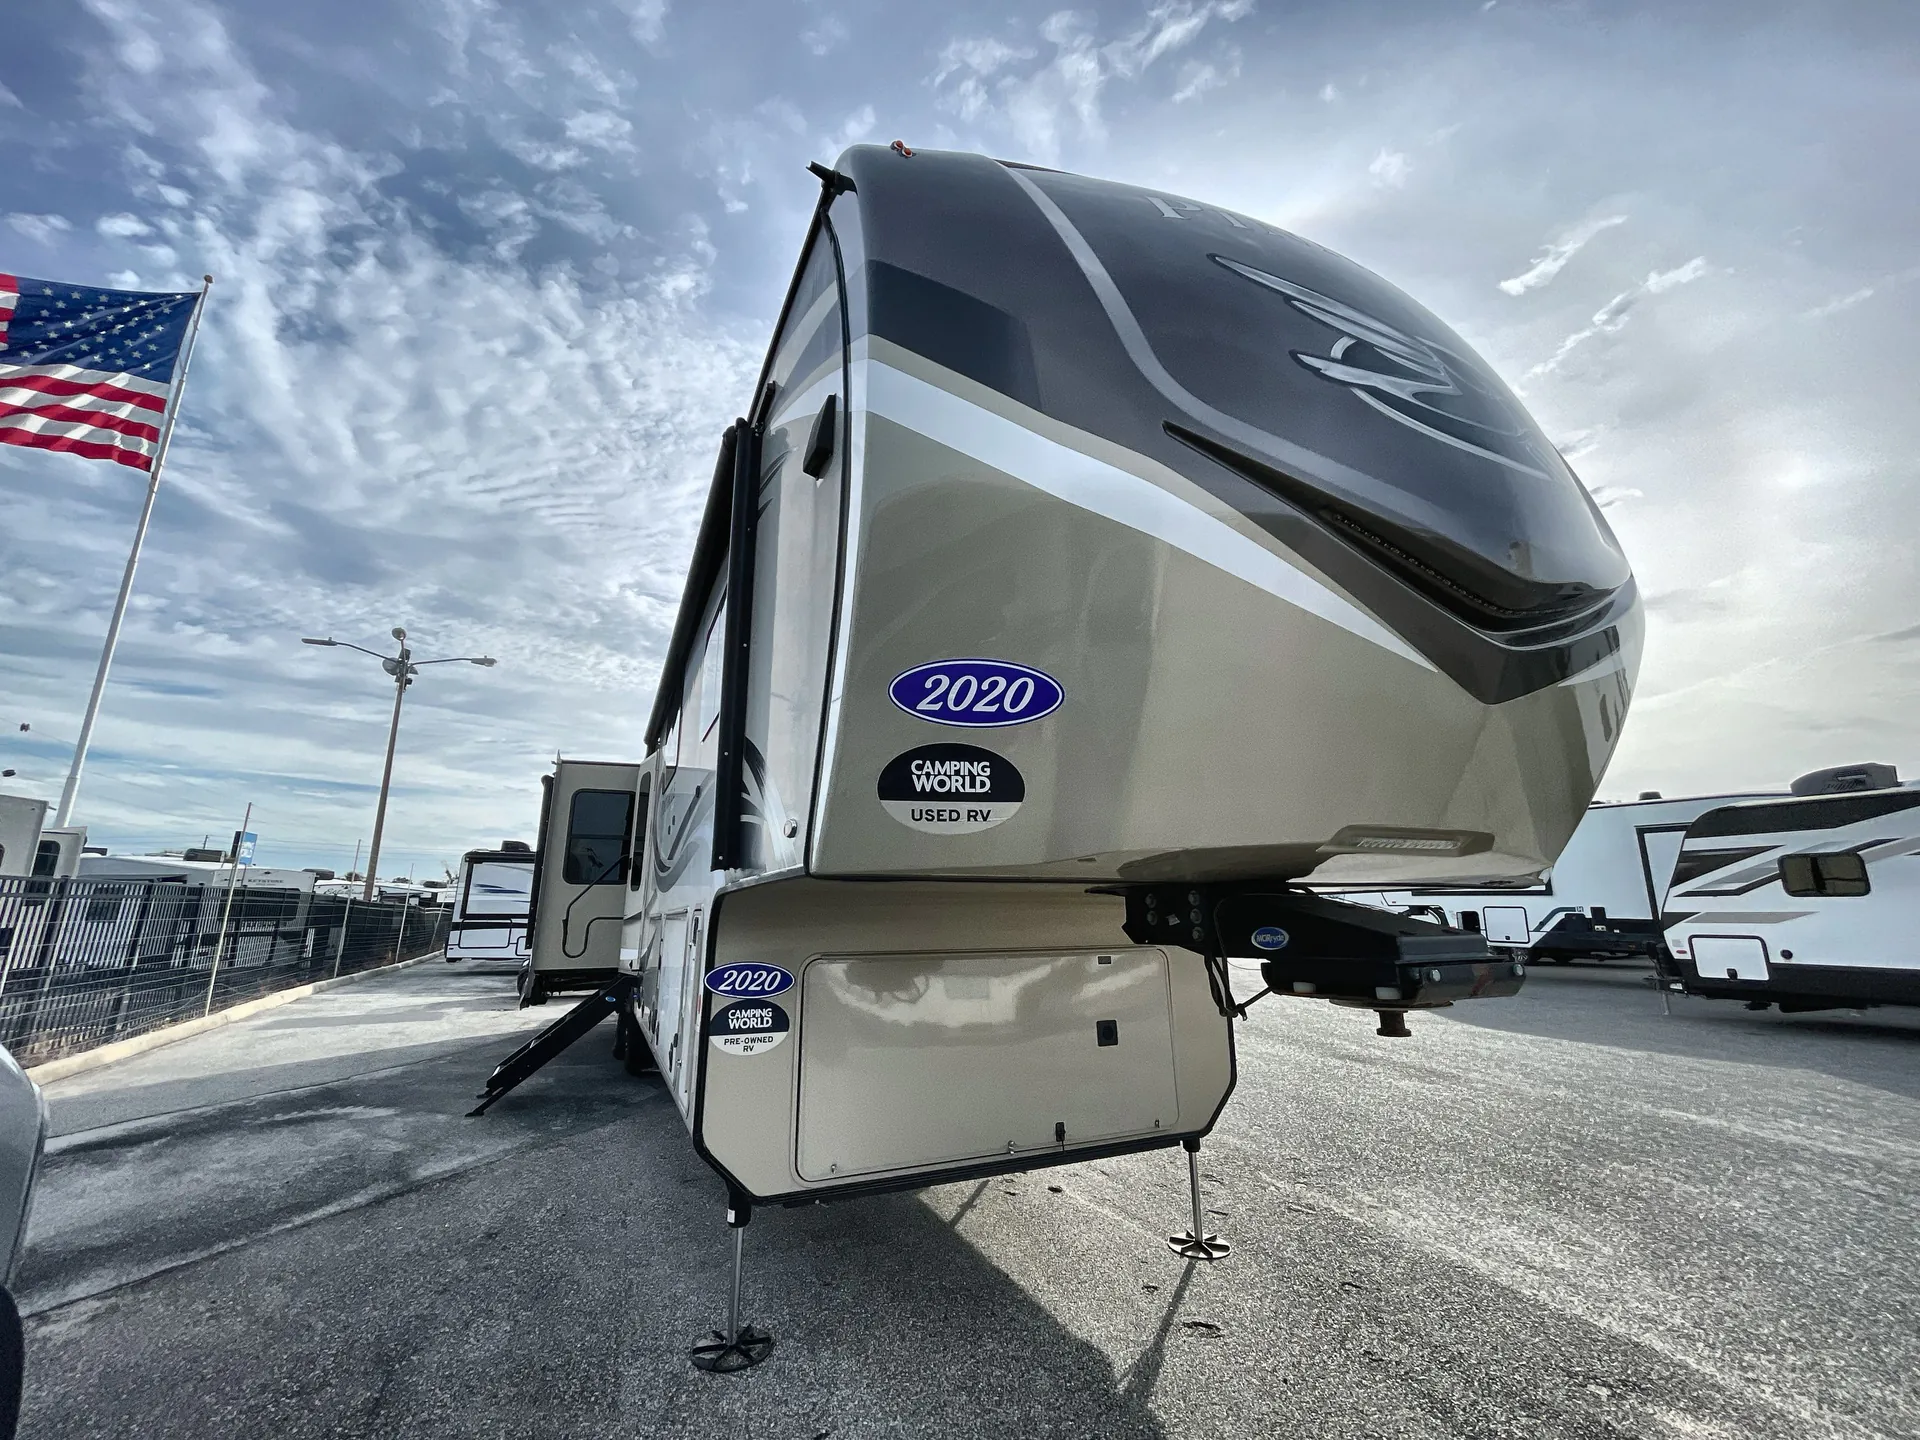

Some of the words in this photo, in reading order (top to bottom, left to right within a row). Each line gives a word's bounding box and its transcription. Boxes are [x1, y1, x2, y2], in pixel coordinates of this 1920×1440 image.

[916, 674, 1035, 713] 2020
[910, 760, 991, 776] CAMPING
[911, 775, 991, 793] WORLD
[911, 808, 961, 822] USED
[966, 809, 992, 822] RV
[718, 970, 781, 991] 2020
[728, 1008, 773, 1019] CAMPING
[728, 1017, 772, 1030] WORLD
[724, 1036, 774, 1046] PRE-OWNED
[742, 1045, 754, 1053] RV
